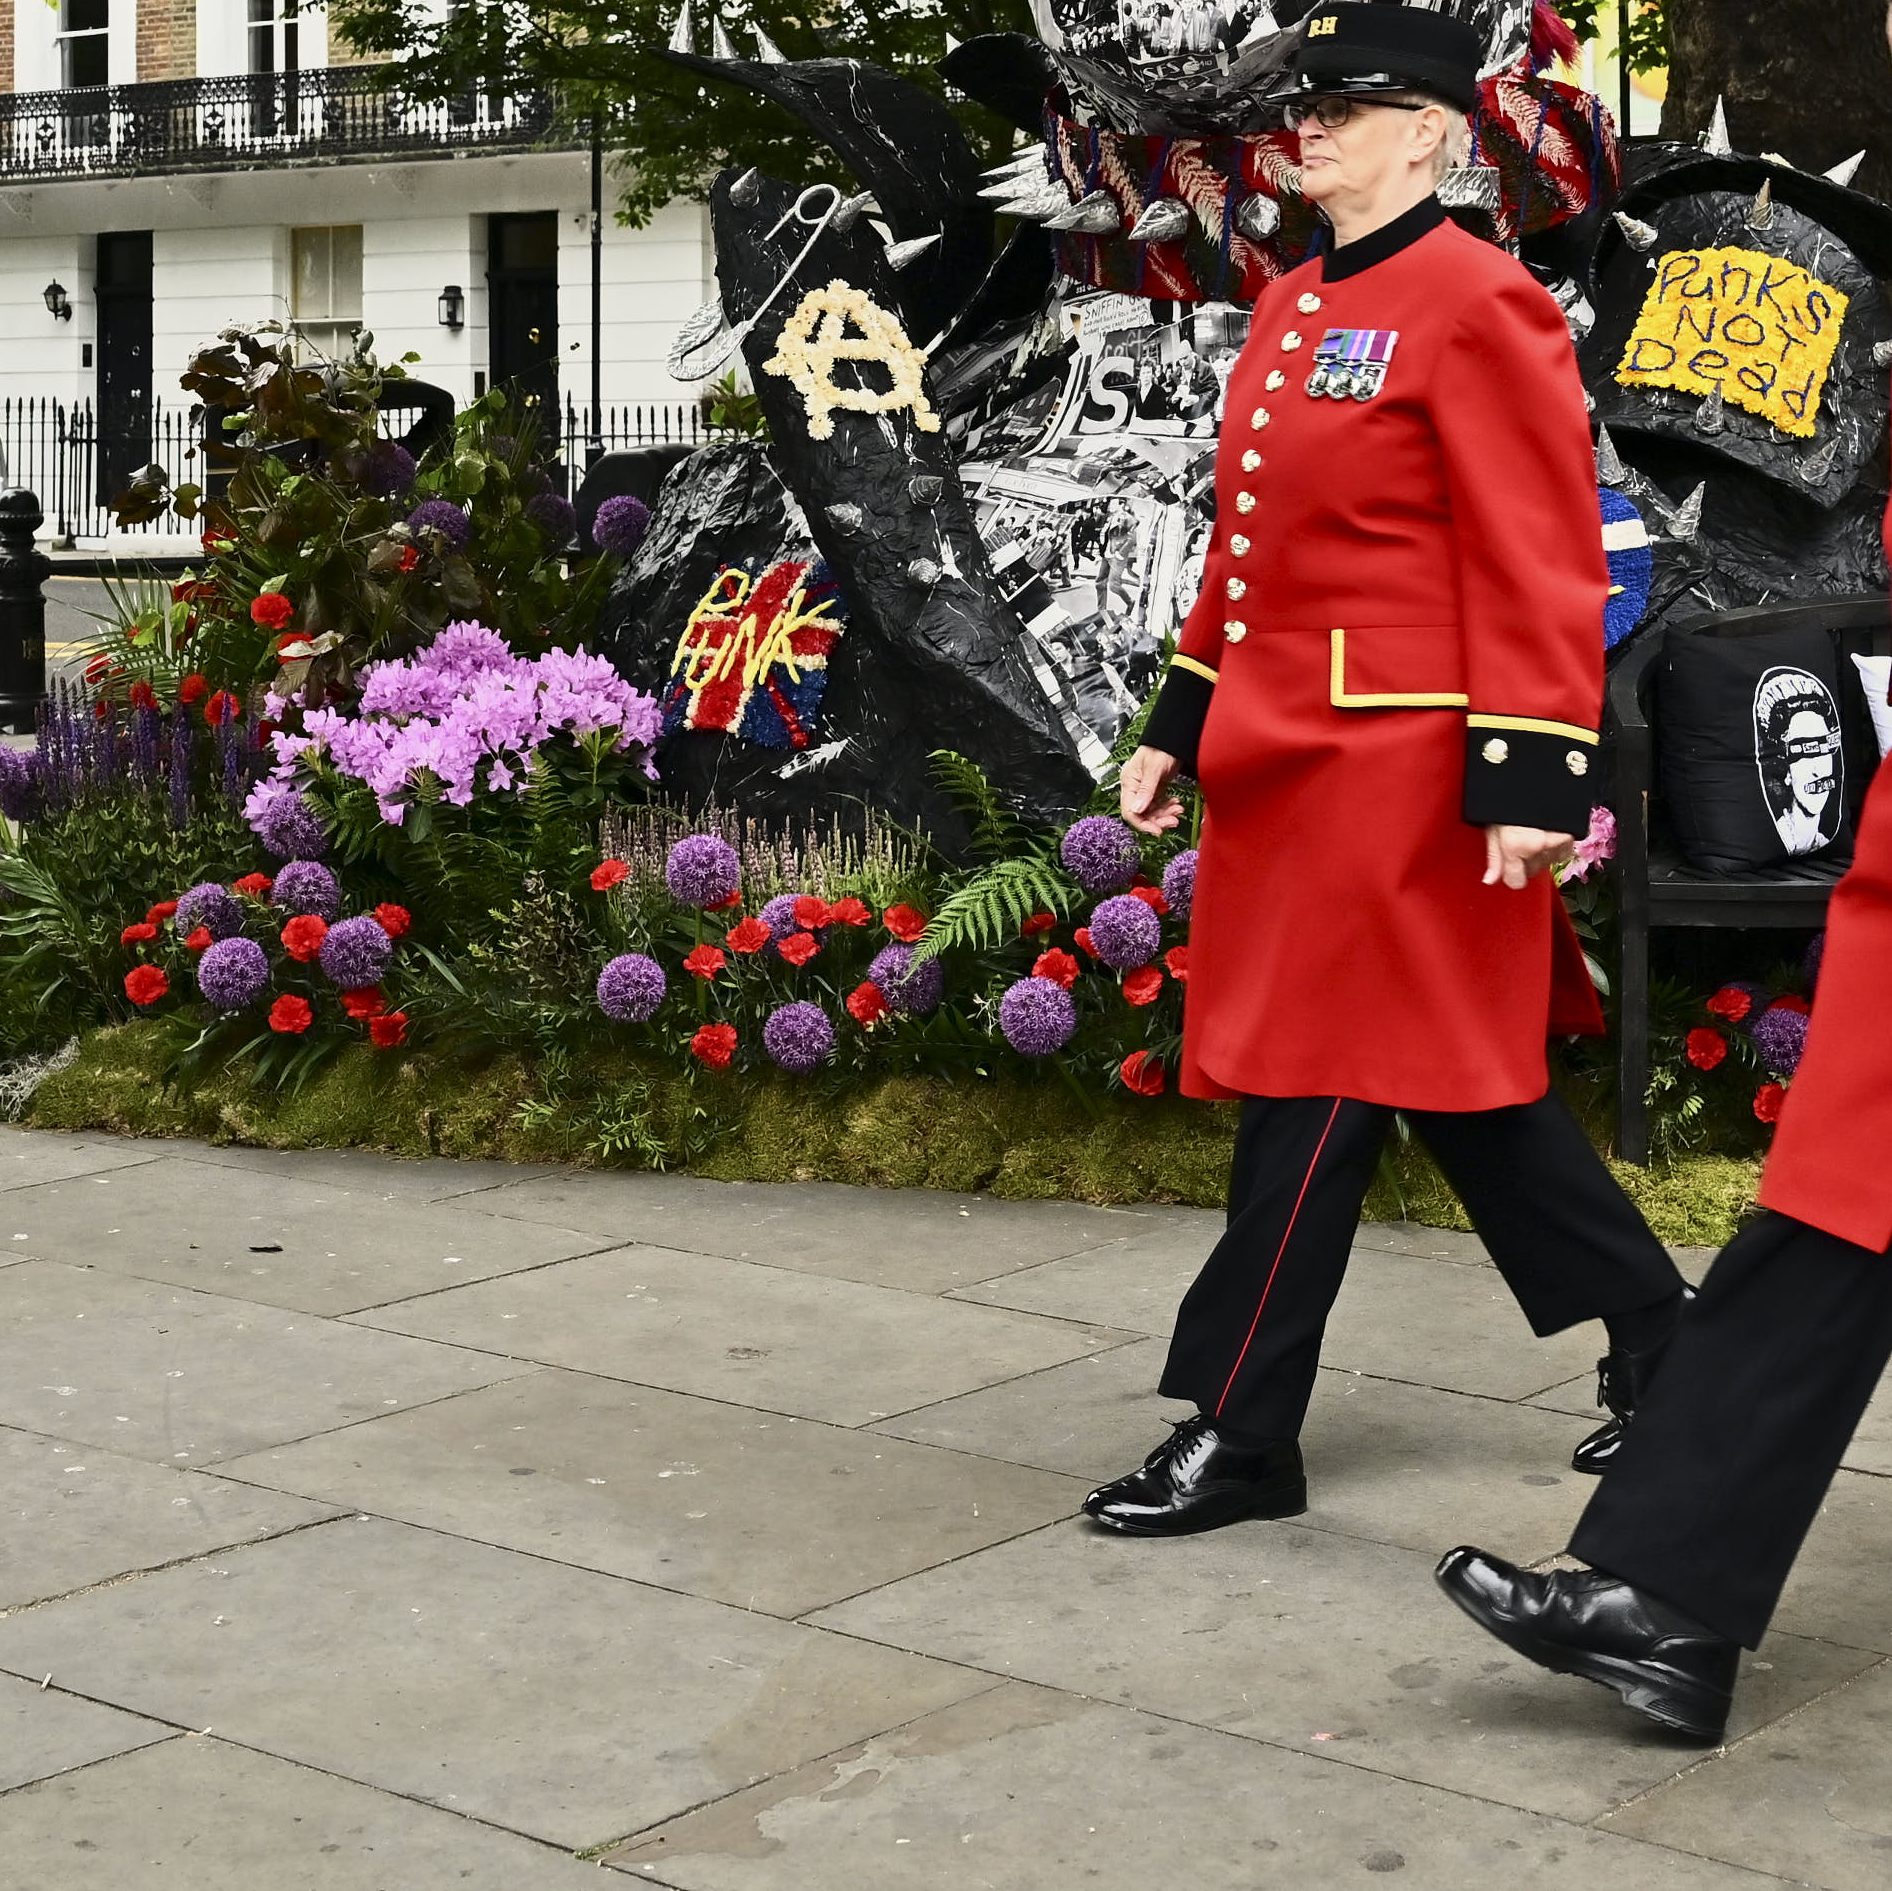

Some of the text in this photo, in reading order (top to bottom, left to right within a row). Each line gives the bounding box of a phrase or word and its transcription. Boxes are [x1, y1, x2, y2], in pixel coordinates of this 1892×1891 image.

[1307, 16, 1339, 38] RH
[1673, 304, 1807, 362] NOT
[1627, 338, 1815, 419] Dead
[670, 567, 833, 691] PUNK
